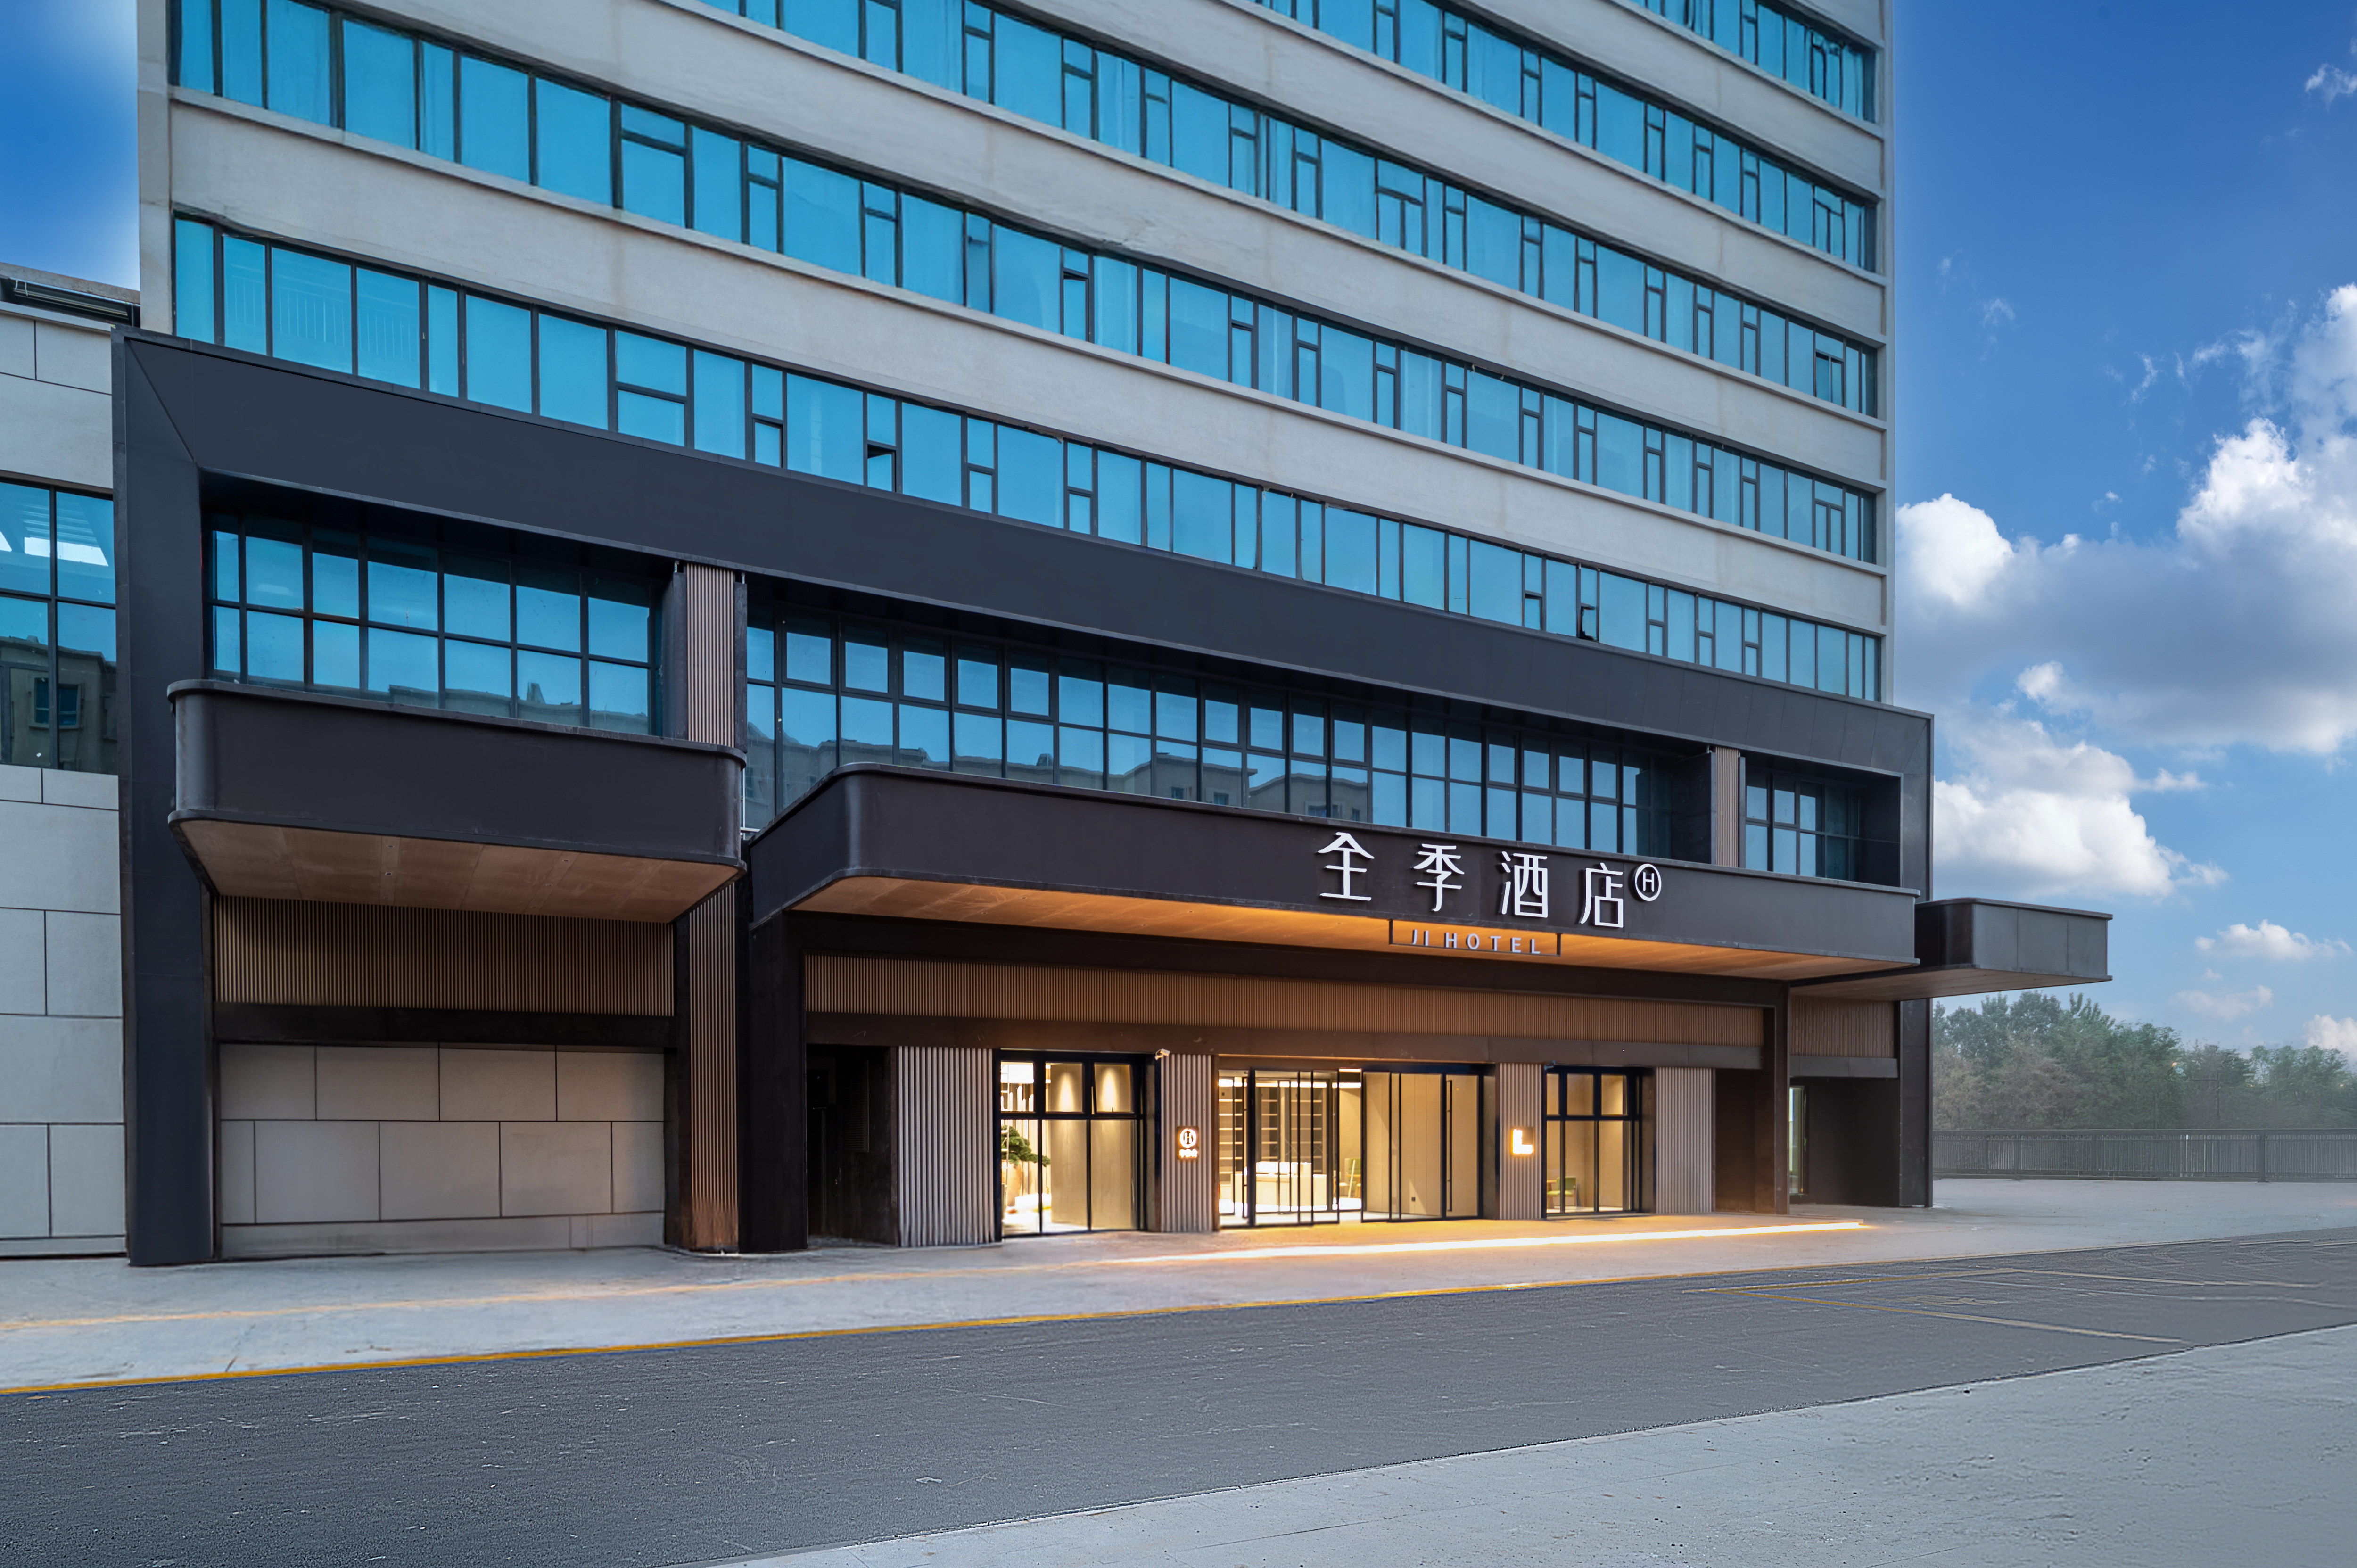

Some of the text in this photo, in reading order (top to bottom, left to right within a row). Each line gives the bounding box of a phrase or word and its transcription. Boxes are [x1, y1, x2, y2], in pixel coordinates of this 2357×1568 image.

[1317, 832, 1624, 928] 全季酒店
[1412, 929, 1541, 954] JI HOTEL
